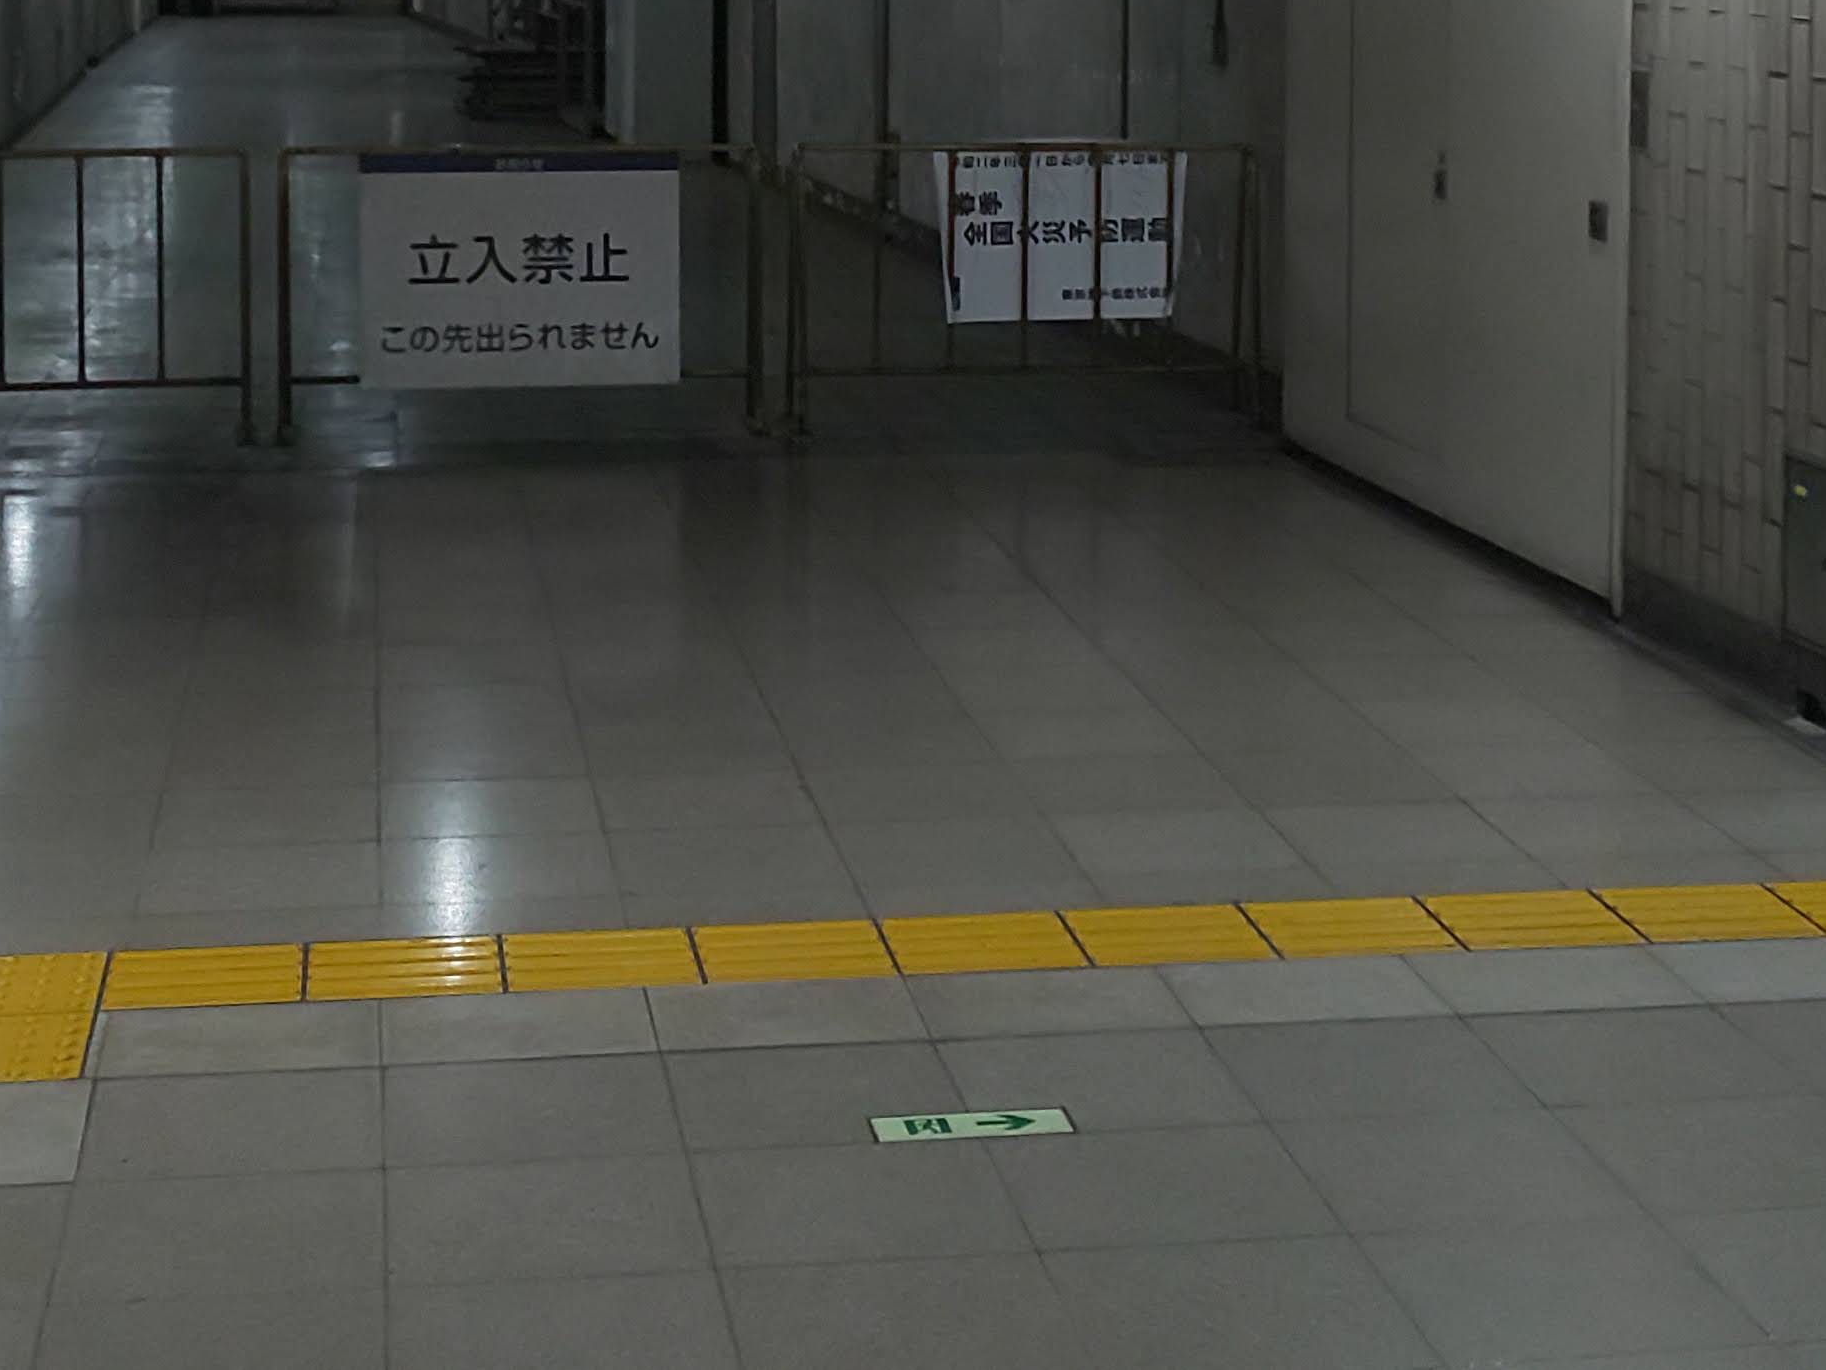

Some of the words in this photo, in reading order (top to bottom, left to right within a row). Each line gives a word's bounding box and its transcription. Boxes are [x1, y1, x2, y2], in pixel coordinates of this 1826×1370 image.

[408, 233, 630, 285] 立入禁止
[381, 322, 659, 353] この先出られません
